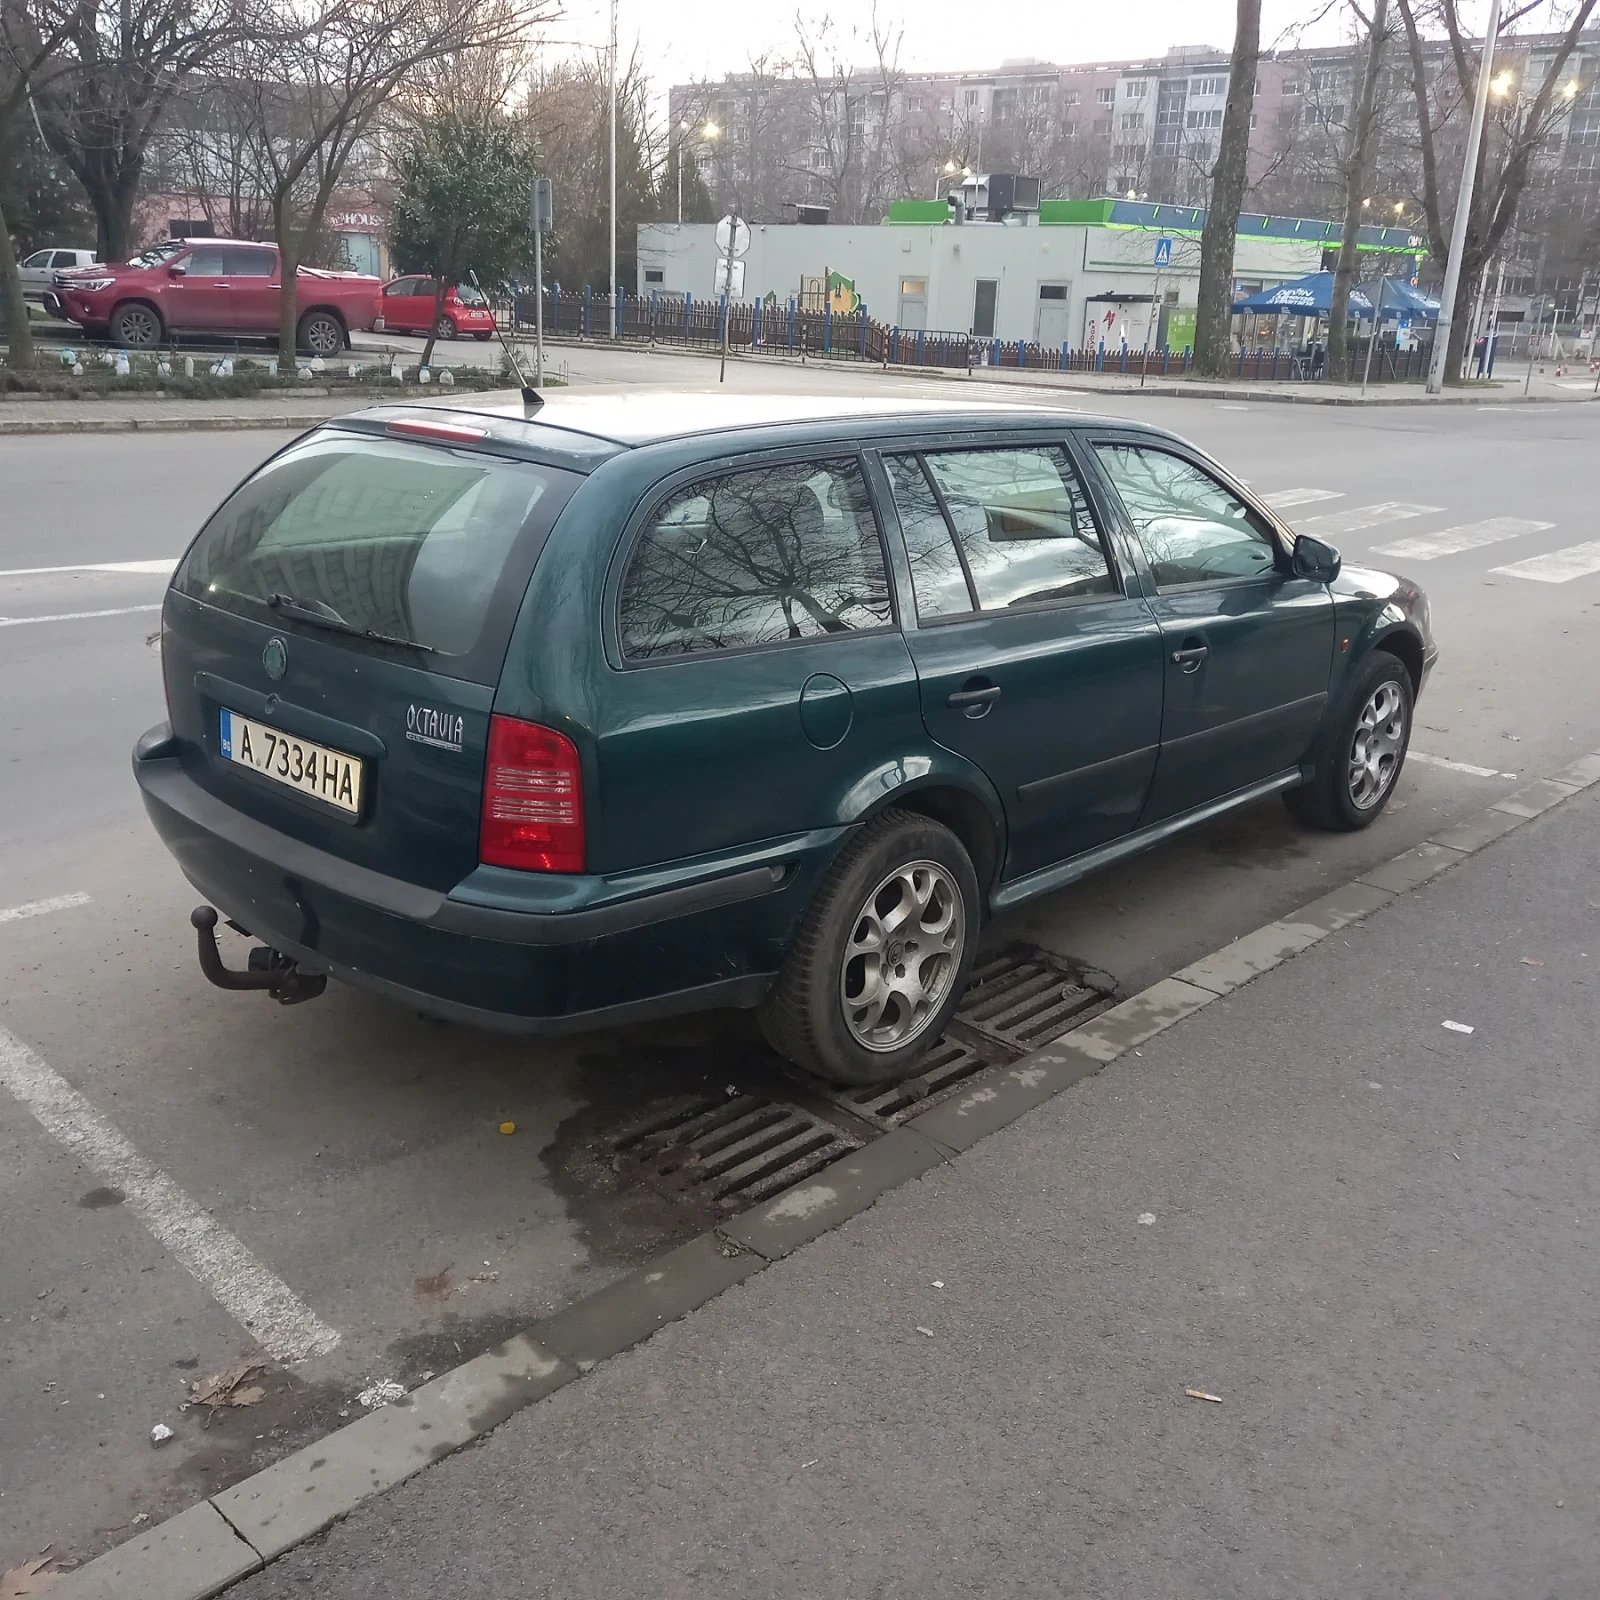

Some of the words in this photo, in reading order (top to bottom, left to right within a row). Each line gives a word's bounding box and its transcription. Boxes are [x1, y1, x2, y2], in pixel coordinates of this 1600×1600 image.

[1276, 288, 1314, 297] DEVIN
[406, 704, 463, 743] OCTAVIA
[222, 739, 231, 752] BG
